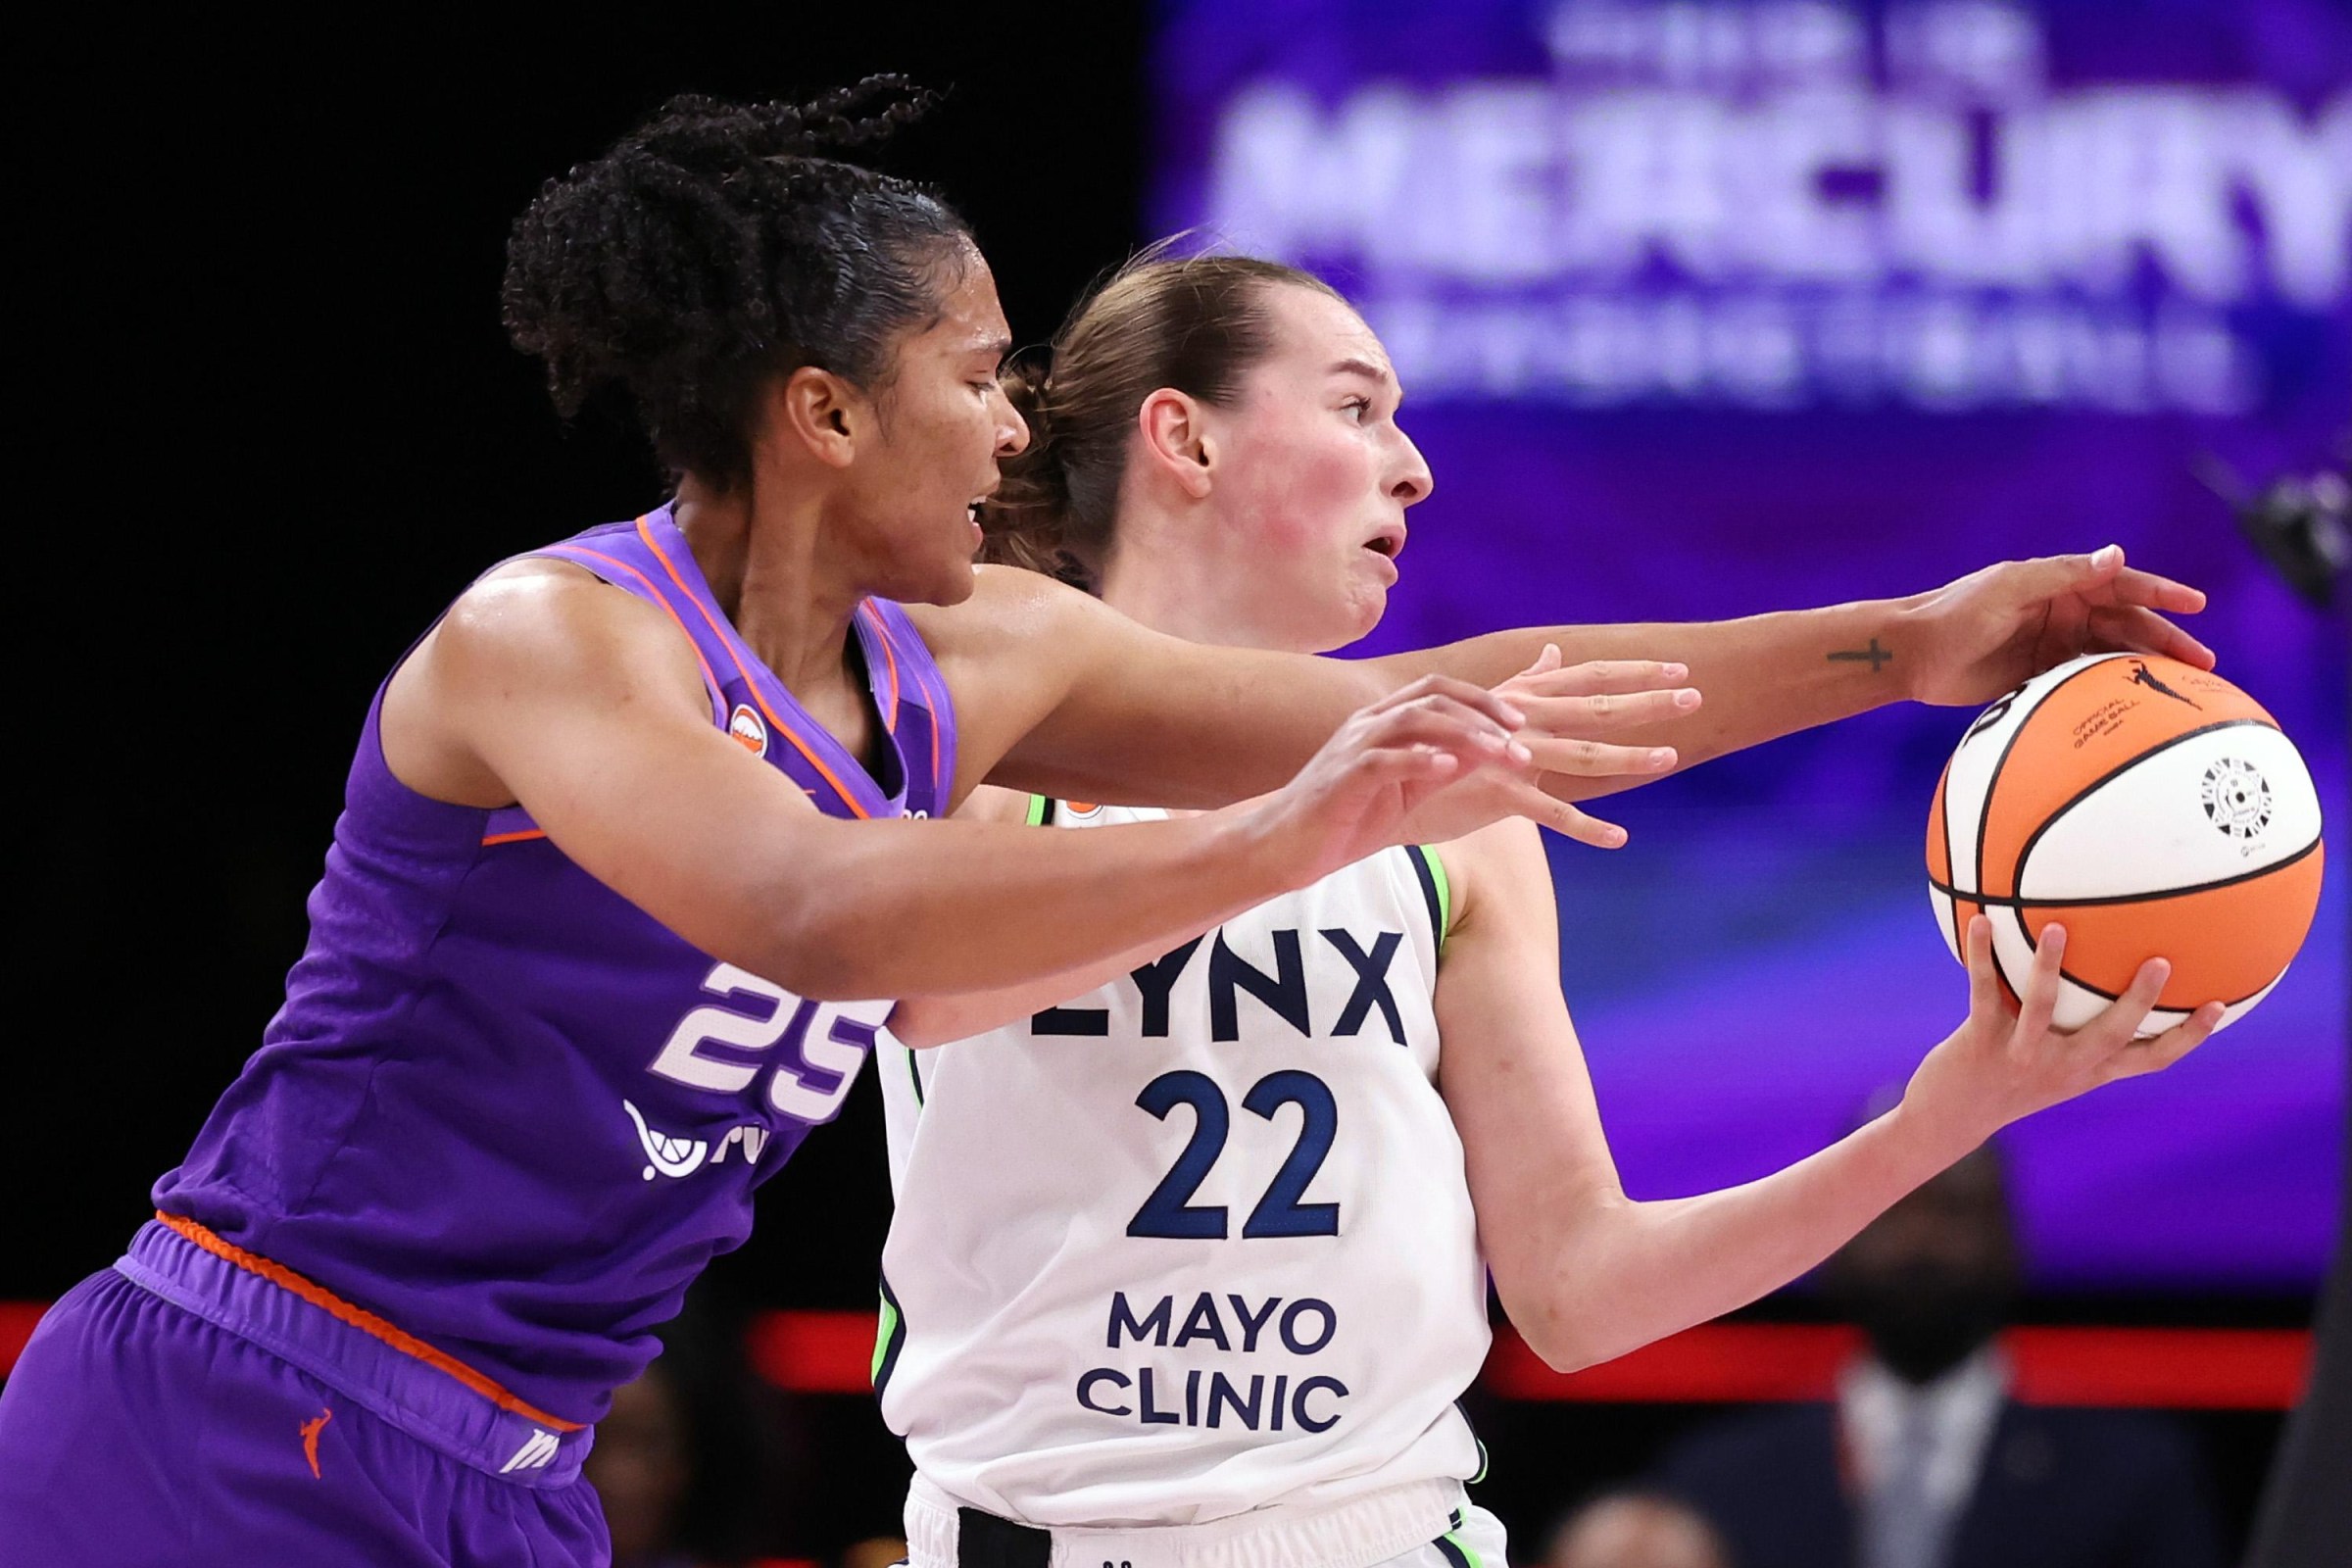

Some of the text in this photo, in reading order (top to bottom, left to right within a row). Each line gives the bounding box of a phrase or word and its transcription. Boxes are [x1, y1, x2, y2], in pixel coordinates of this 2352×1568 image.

[645, 959, 899, 1126] 25
[1126, 1068, 1341, 1241] 22
[1105, 1291, 1338, 1356] MAYO
[1077, 1366, 1350, 1434] CLINIC
